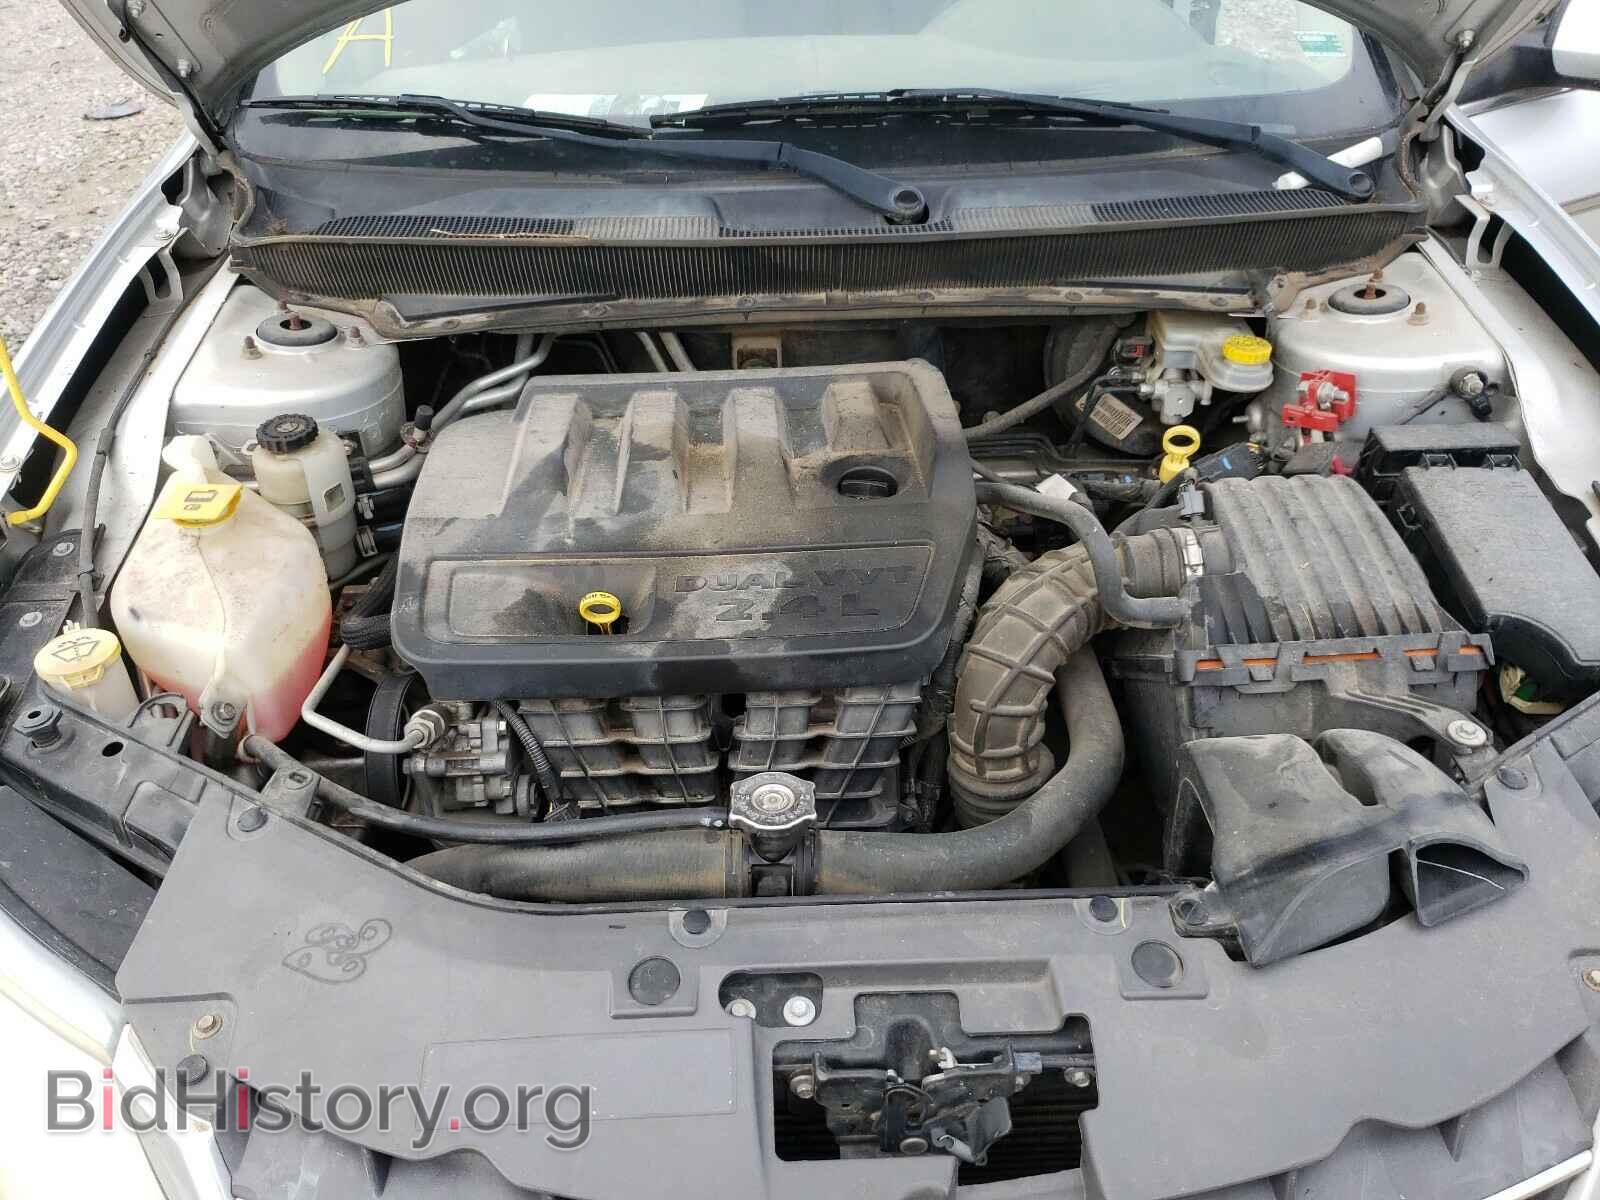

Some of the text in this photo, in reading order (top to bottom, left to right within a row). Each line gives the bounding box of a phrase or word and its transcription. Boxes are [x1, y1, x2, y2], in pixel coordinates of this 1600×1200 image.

[674, 565, 914, 593] DUAL VVT
[715, 592, 881, 622] 2.4L
